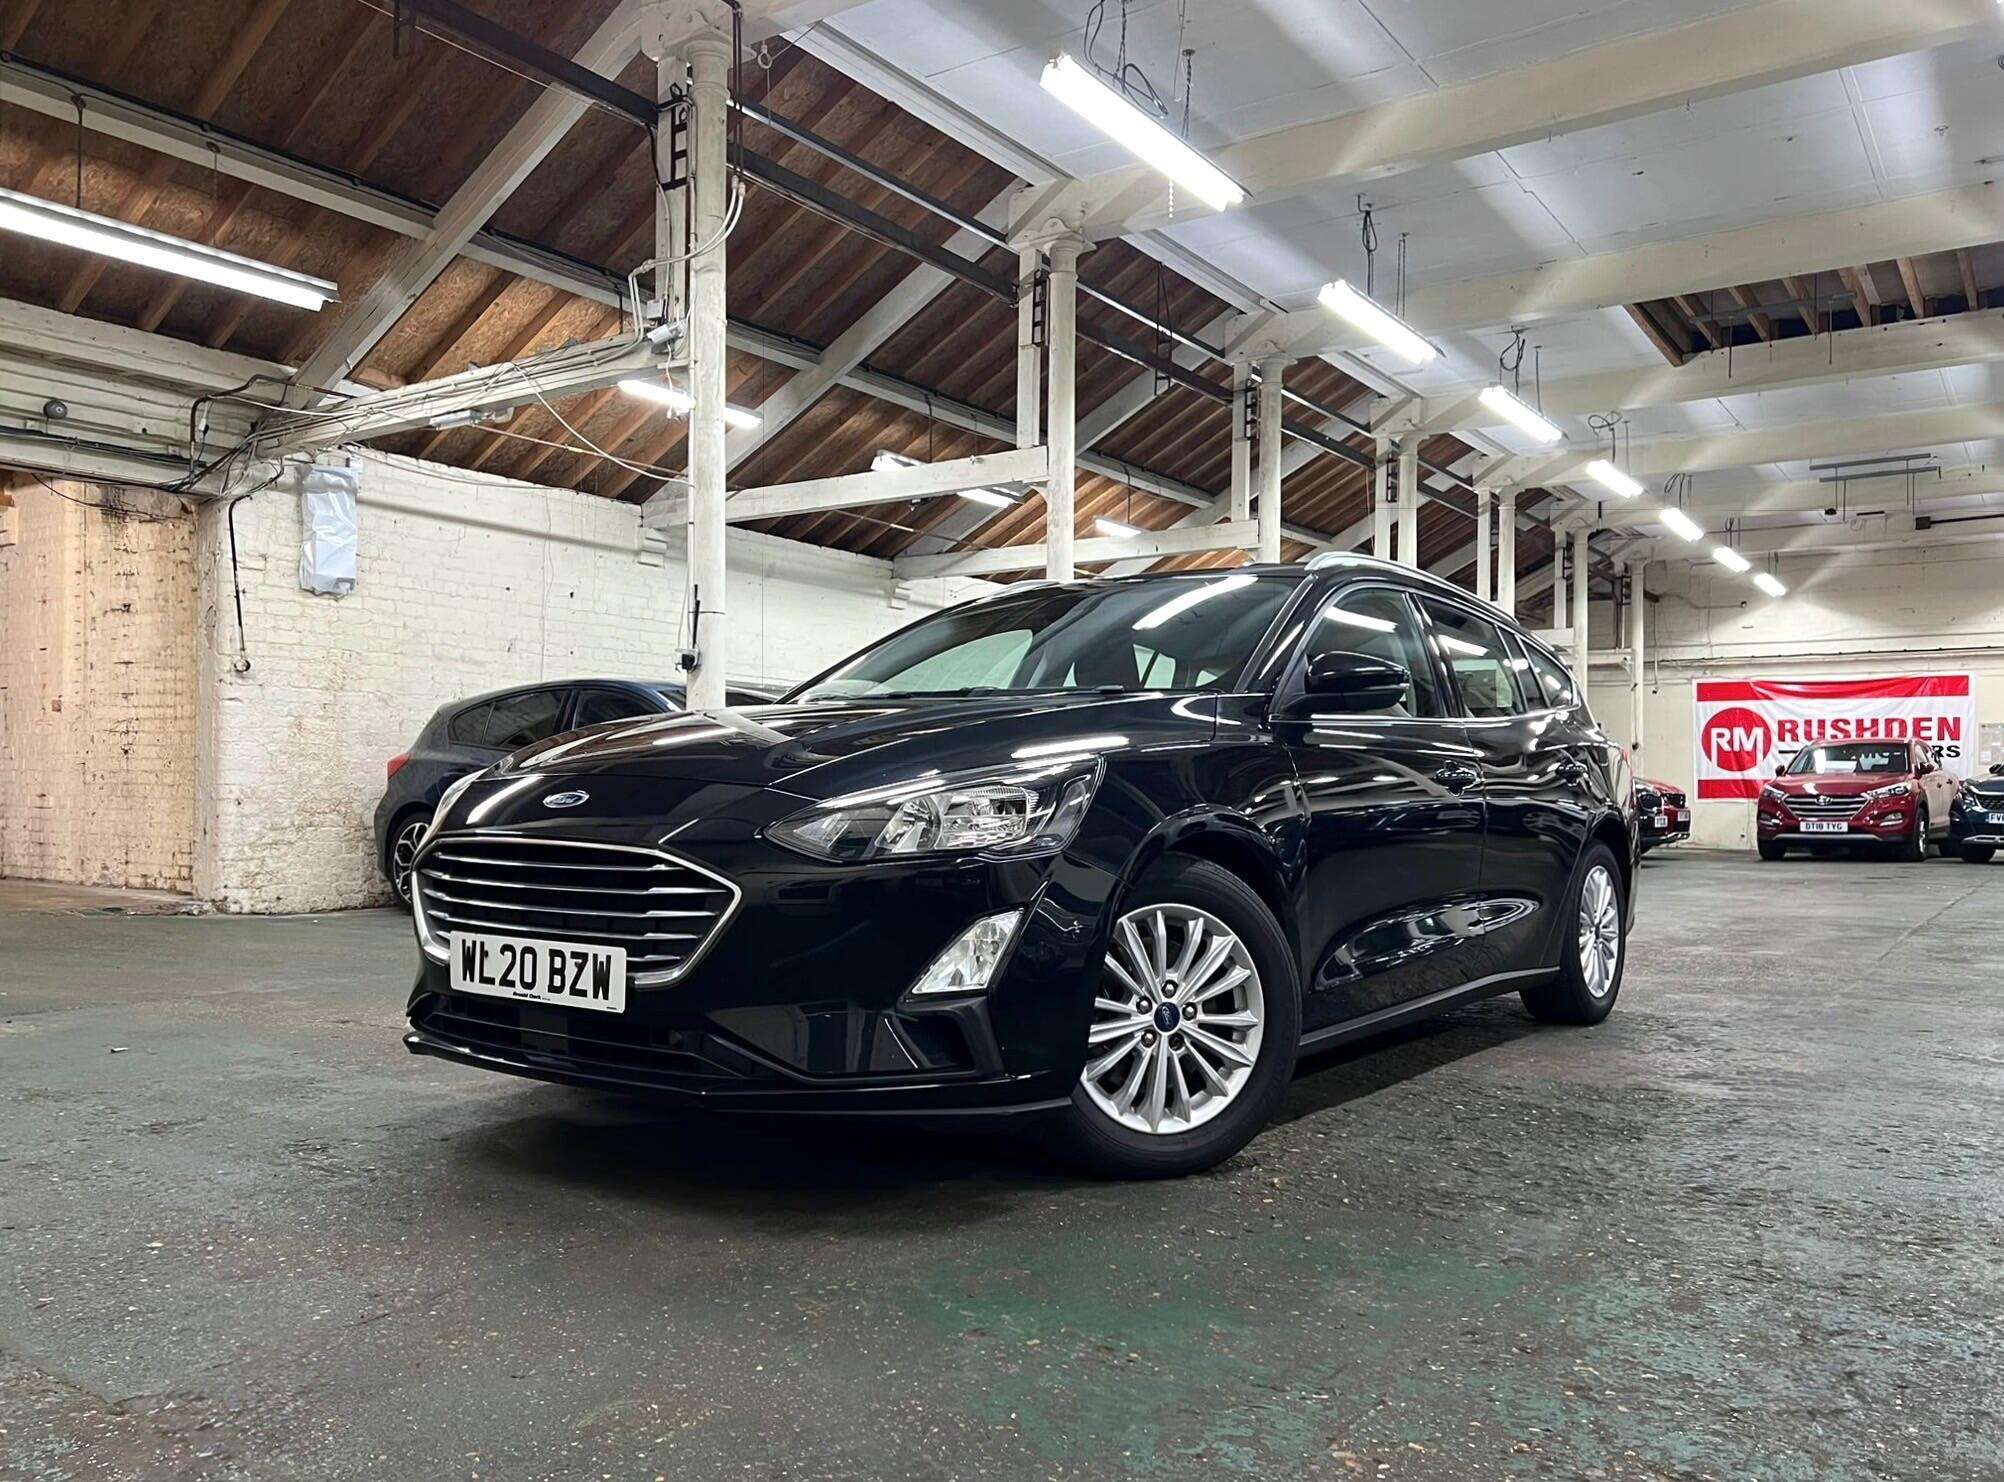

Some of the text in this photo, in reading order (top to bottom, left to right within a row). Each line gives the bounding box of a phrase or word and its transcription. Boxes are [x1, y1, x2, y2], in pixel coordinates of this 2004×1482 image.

[1711, 726, 1763, 765] RM
[1777, 717, 1960, 742] RUSHDEN
[462, 938, 612, 1000] WL20 BZW
